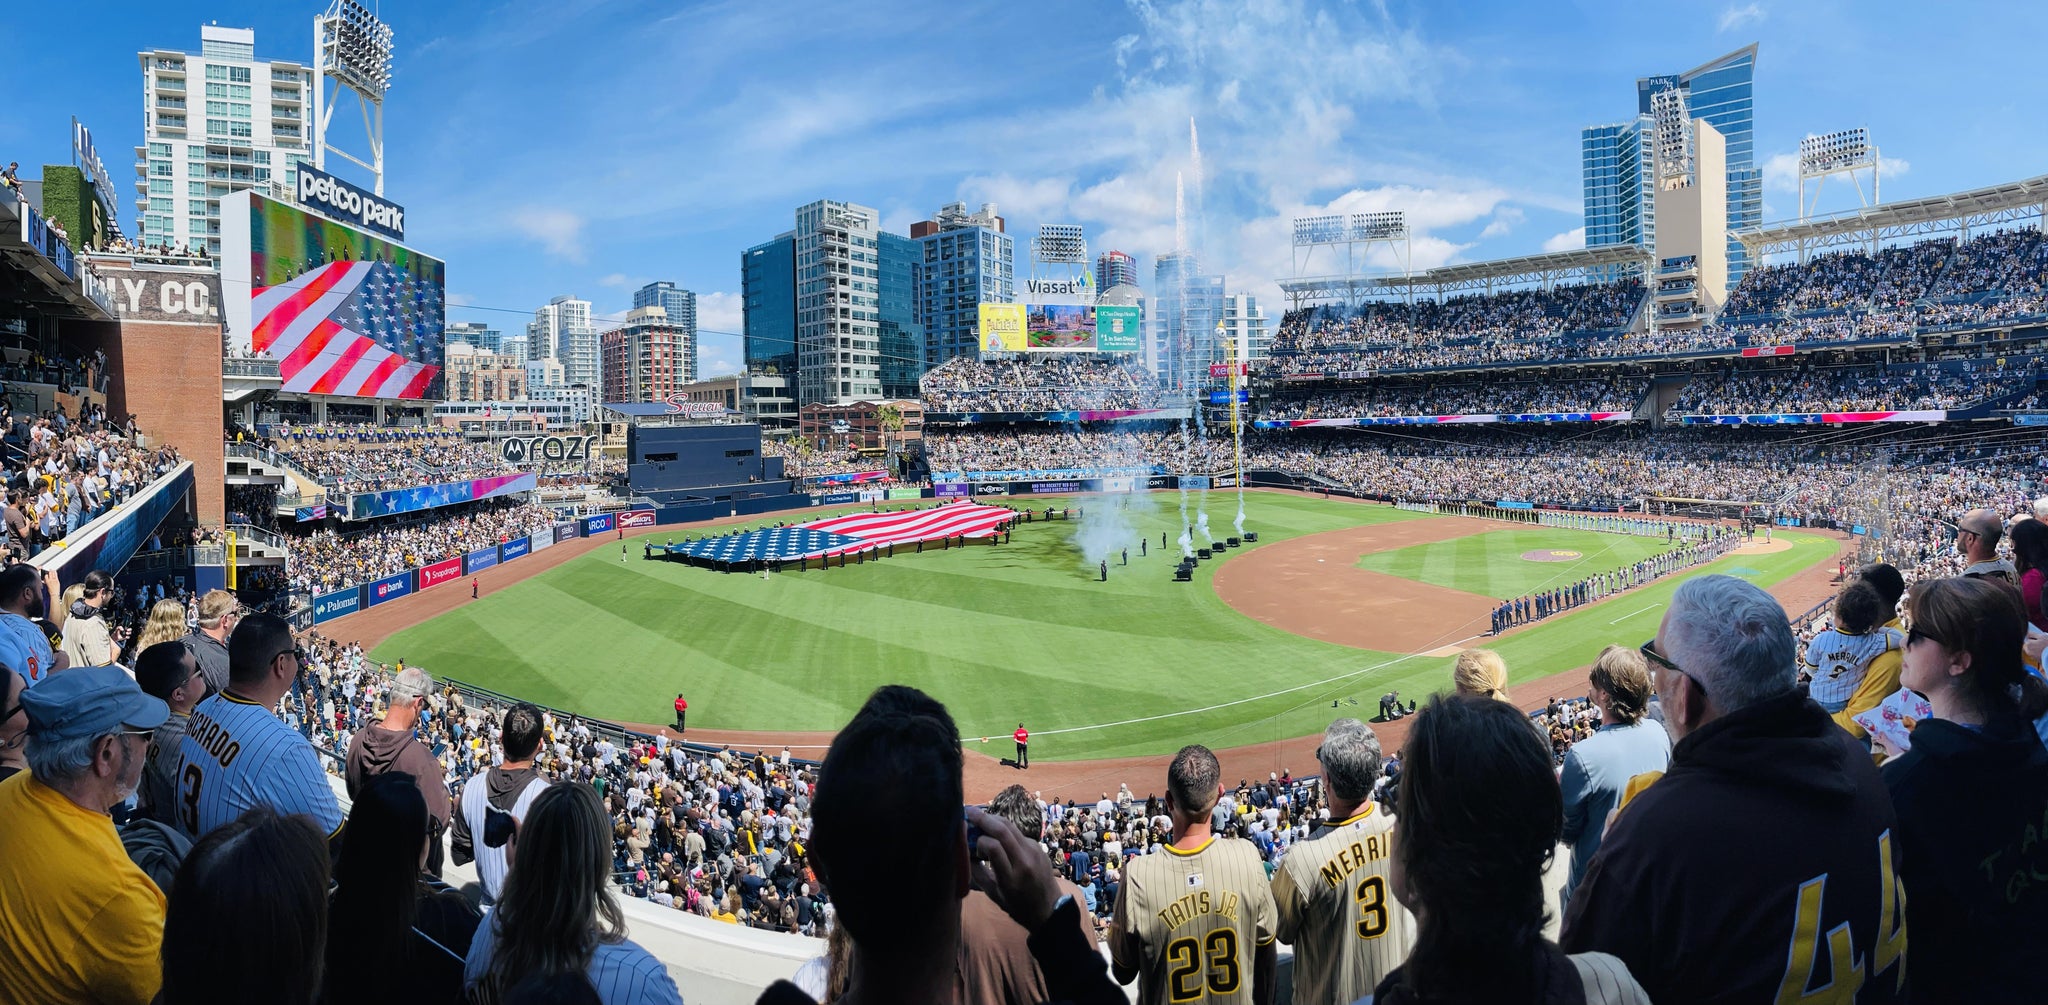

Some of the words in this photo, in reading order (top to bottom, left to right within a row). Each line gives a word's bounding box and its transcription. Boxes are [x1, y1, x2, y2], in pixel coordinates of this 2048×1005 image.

[300, 170, 361, 215] petco
[363, 197, 404, 233] park
[1028, 280, 1075, 294] Viasat
[666, 393, 723, 418] Sycuan
[528, 435, 598, 461] razr
[620, 512, 651, 527] Sycuan
[504, 543, 524, 556] Southwest
[432, 565, 459, 579] Snapdragon
[387, 580, 404, 592] bank
[327, 596, 358, 612] Palomar
[300, 611, 312, 628] 342
[1827, 651, 1860, 666] MERRILL
[1320, 831, 1393, 890] MERRI
[1157, 891, 1210, 931] TATIS
[1214, 889, 1238, 922] JR.
[1354, 874, 1390, 940] 3
[1167, 926, 1241, 1004] 23
